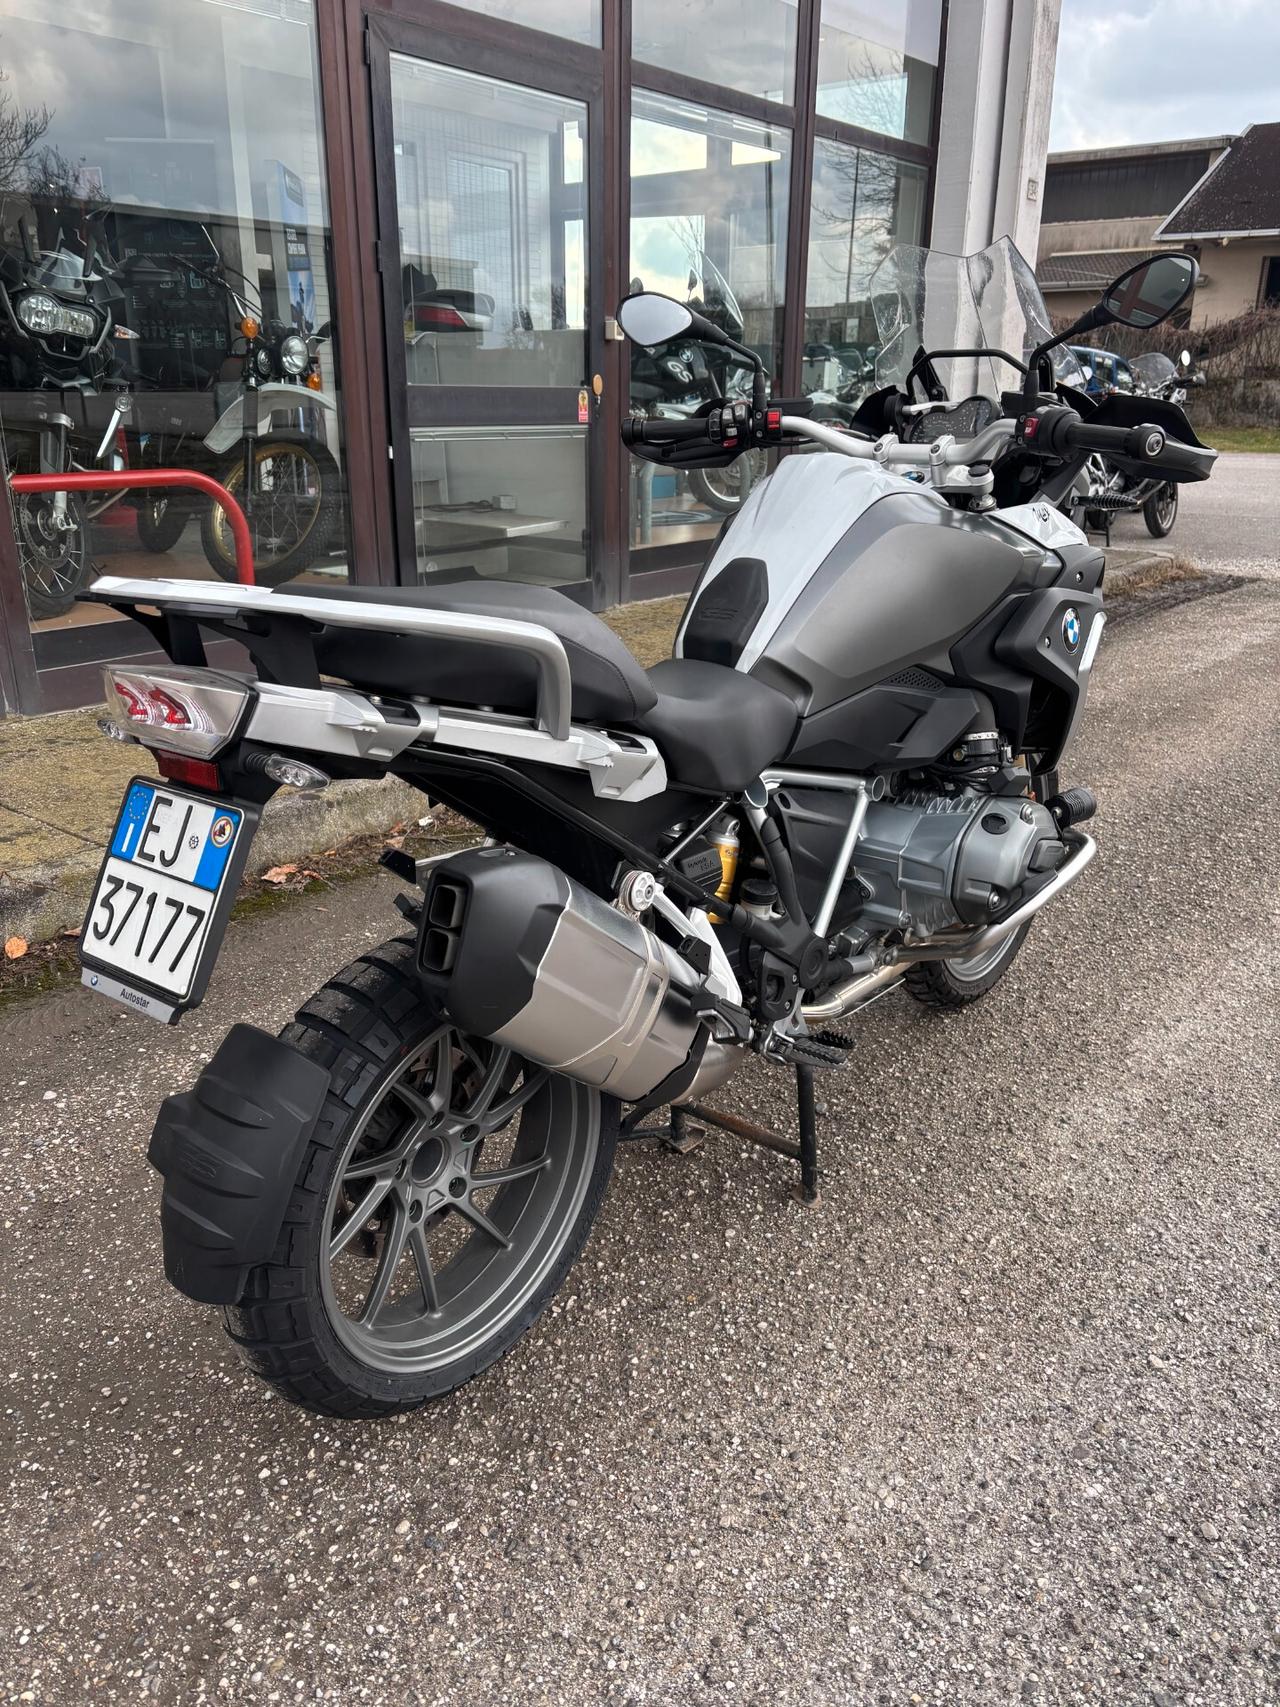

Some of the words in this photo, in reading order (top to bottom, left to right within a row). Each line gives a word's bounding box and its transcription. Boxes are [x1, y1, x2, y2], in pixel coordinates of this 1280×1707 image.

[667, 361, 693, 383] GS
[138, 795, 194, 868] EJ
[93, 874, 206, 973] 37177
[120, 988, 150, 1009] Autostar
